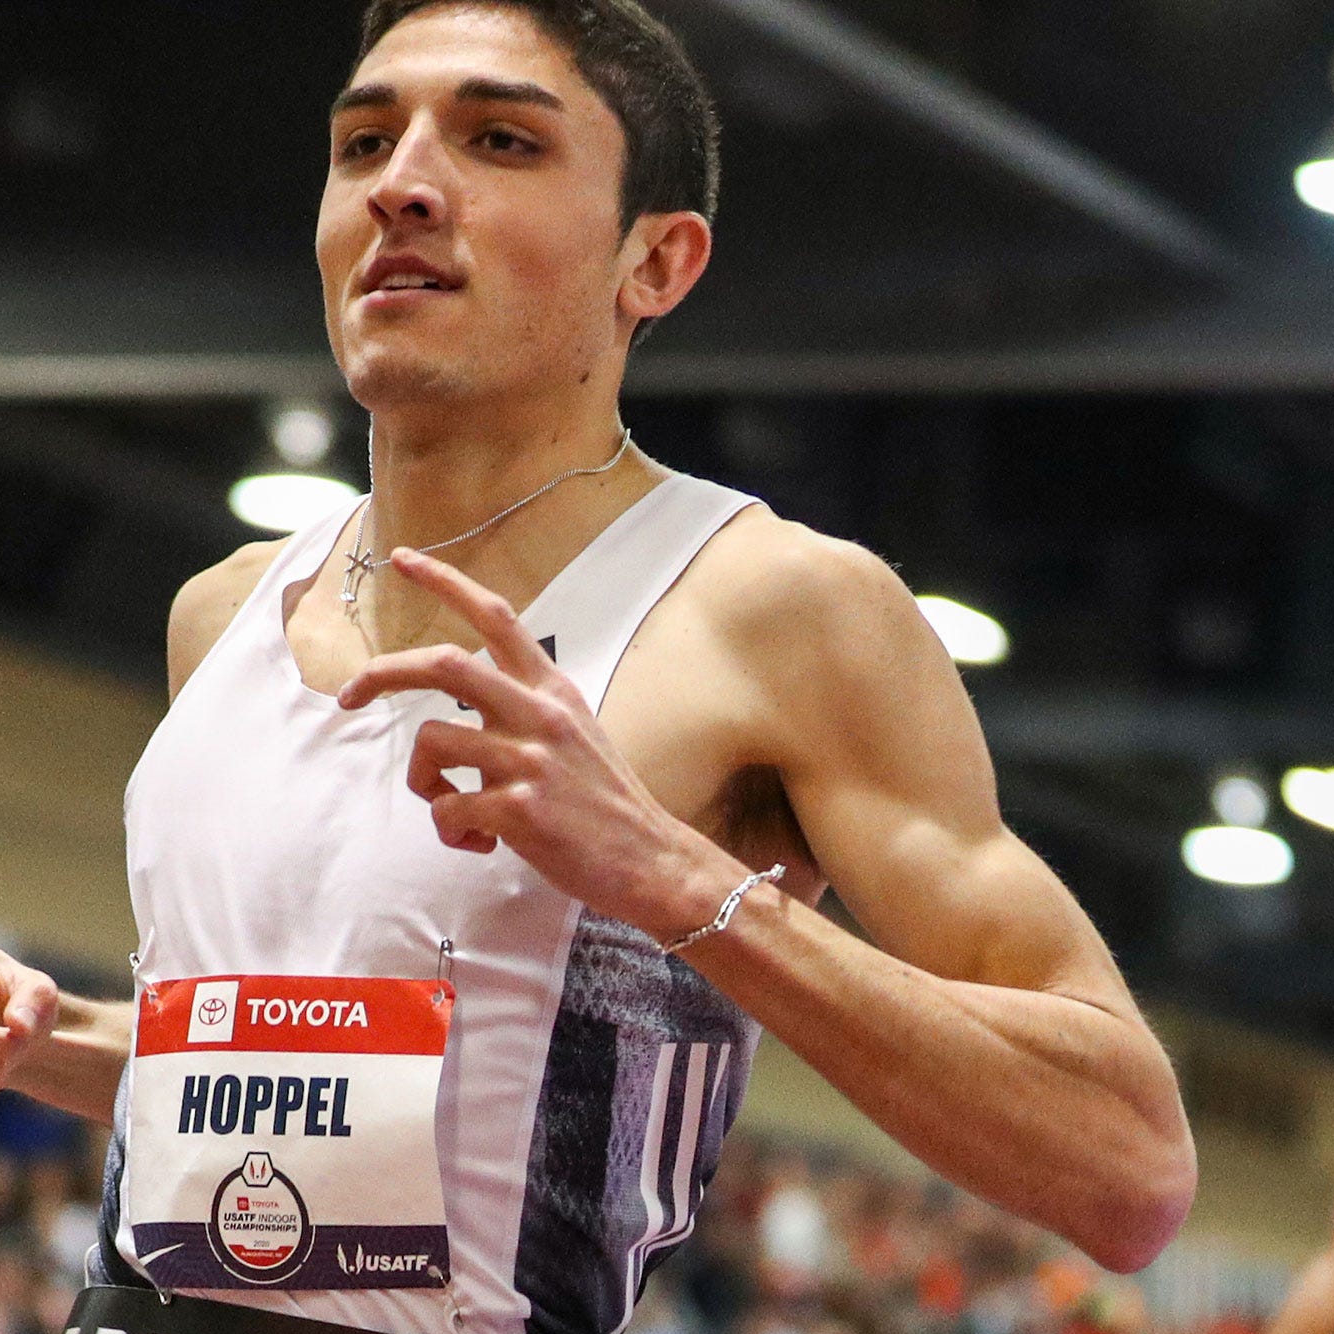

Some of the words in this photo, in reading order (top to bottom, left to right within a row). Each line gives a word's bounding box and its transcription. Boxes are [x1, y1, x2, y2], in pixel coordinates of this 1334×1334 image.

[247, 998, 368, 1028] TOYOTA
[178, 1074, 353, 1137] HOPPEL
[251, 1200, 279, 1208] TOYOTA
[223, 1213, 256, 1221] USATF
[258, 1214, 297, 1223] INDOOR
[223, 1223, 297, 1232] CHAMPIONSHIPS
[365, 1254, 429, 1272] USATF
